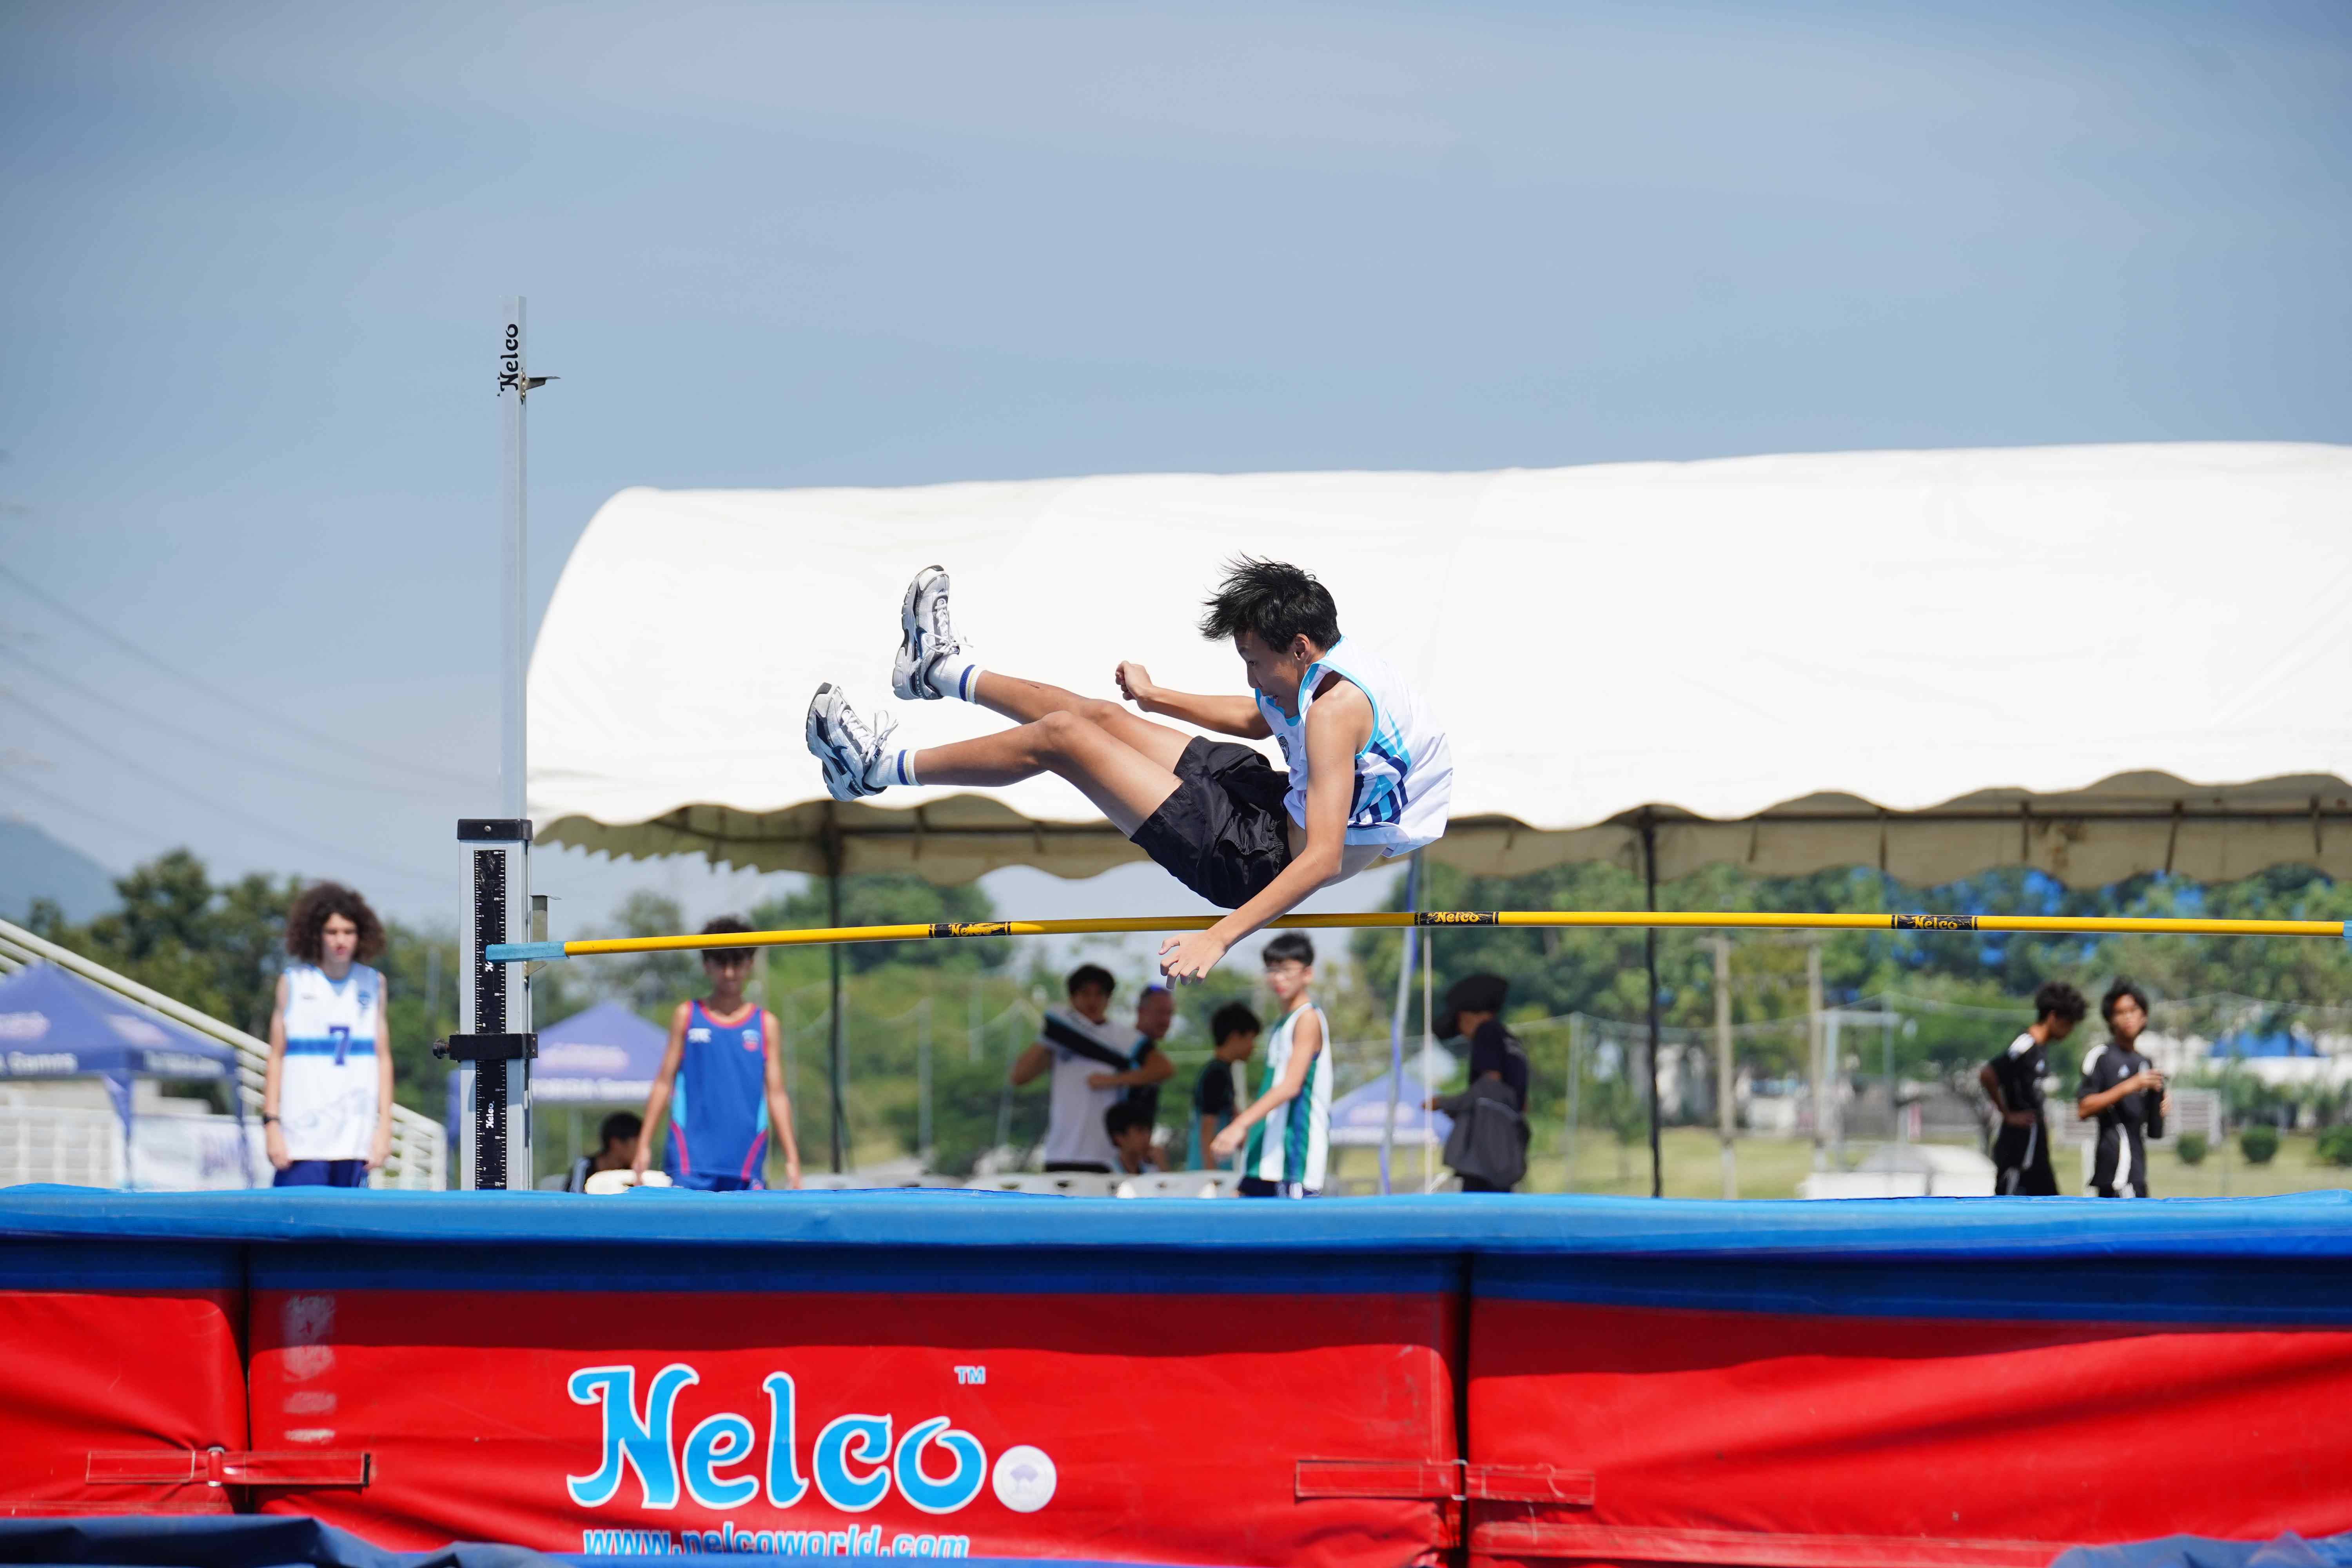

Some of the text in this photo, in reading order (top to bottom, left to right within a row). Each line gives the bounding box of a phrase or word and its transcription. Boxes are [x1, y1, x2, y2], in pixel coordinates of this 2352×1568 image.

[500, 323, 519, 392] Nelco
[873, 746, 882, 759] NIKE
[1434, 911, 1480, 923] Nelco
[1911, 916, 1958, 930] Nelco
[329, 1026, 350, 1065] 7
[485, 1102, 494, 1129] Nelco
[566, 1363, 988, 1514] Nelco TM
[583, 1521, 970, 1557] www.nelcoworld.com
